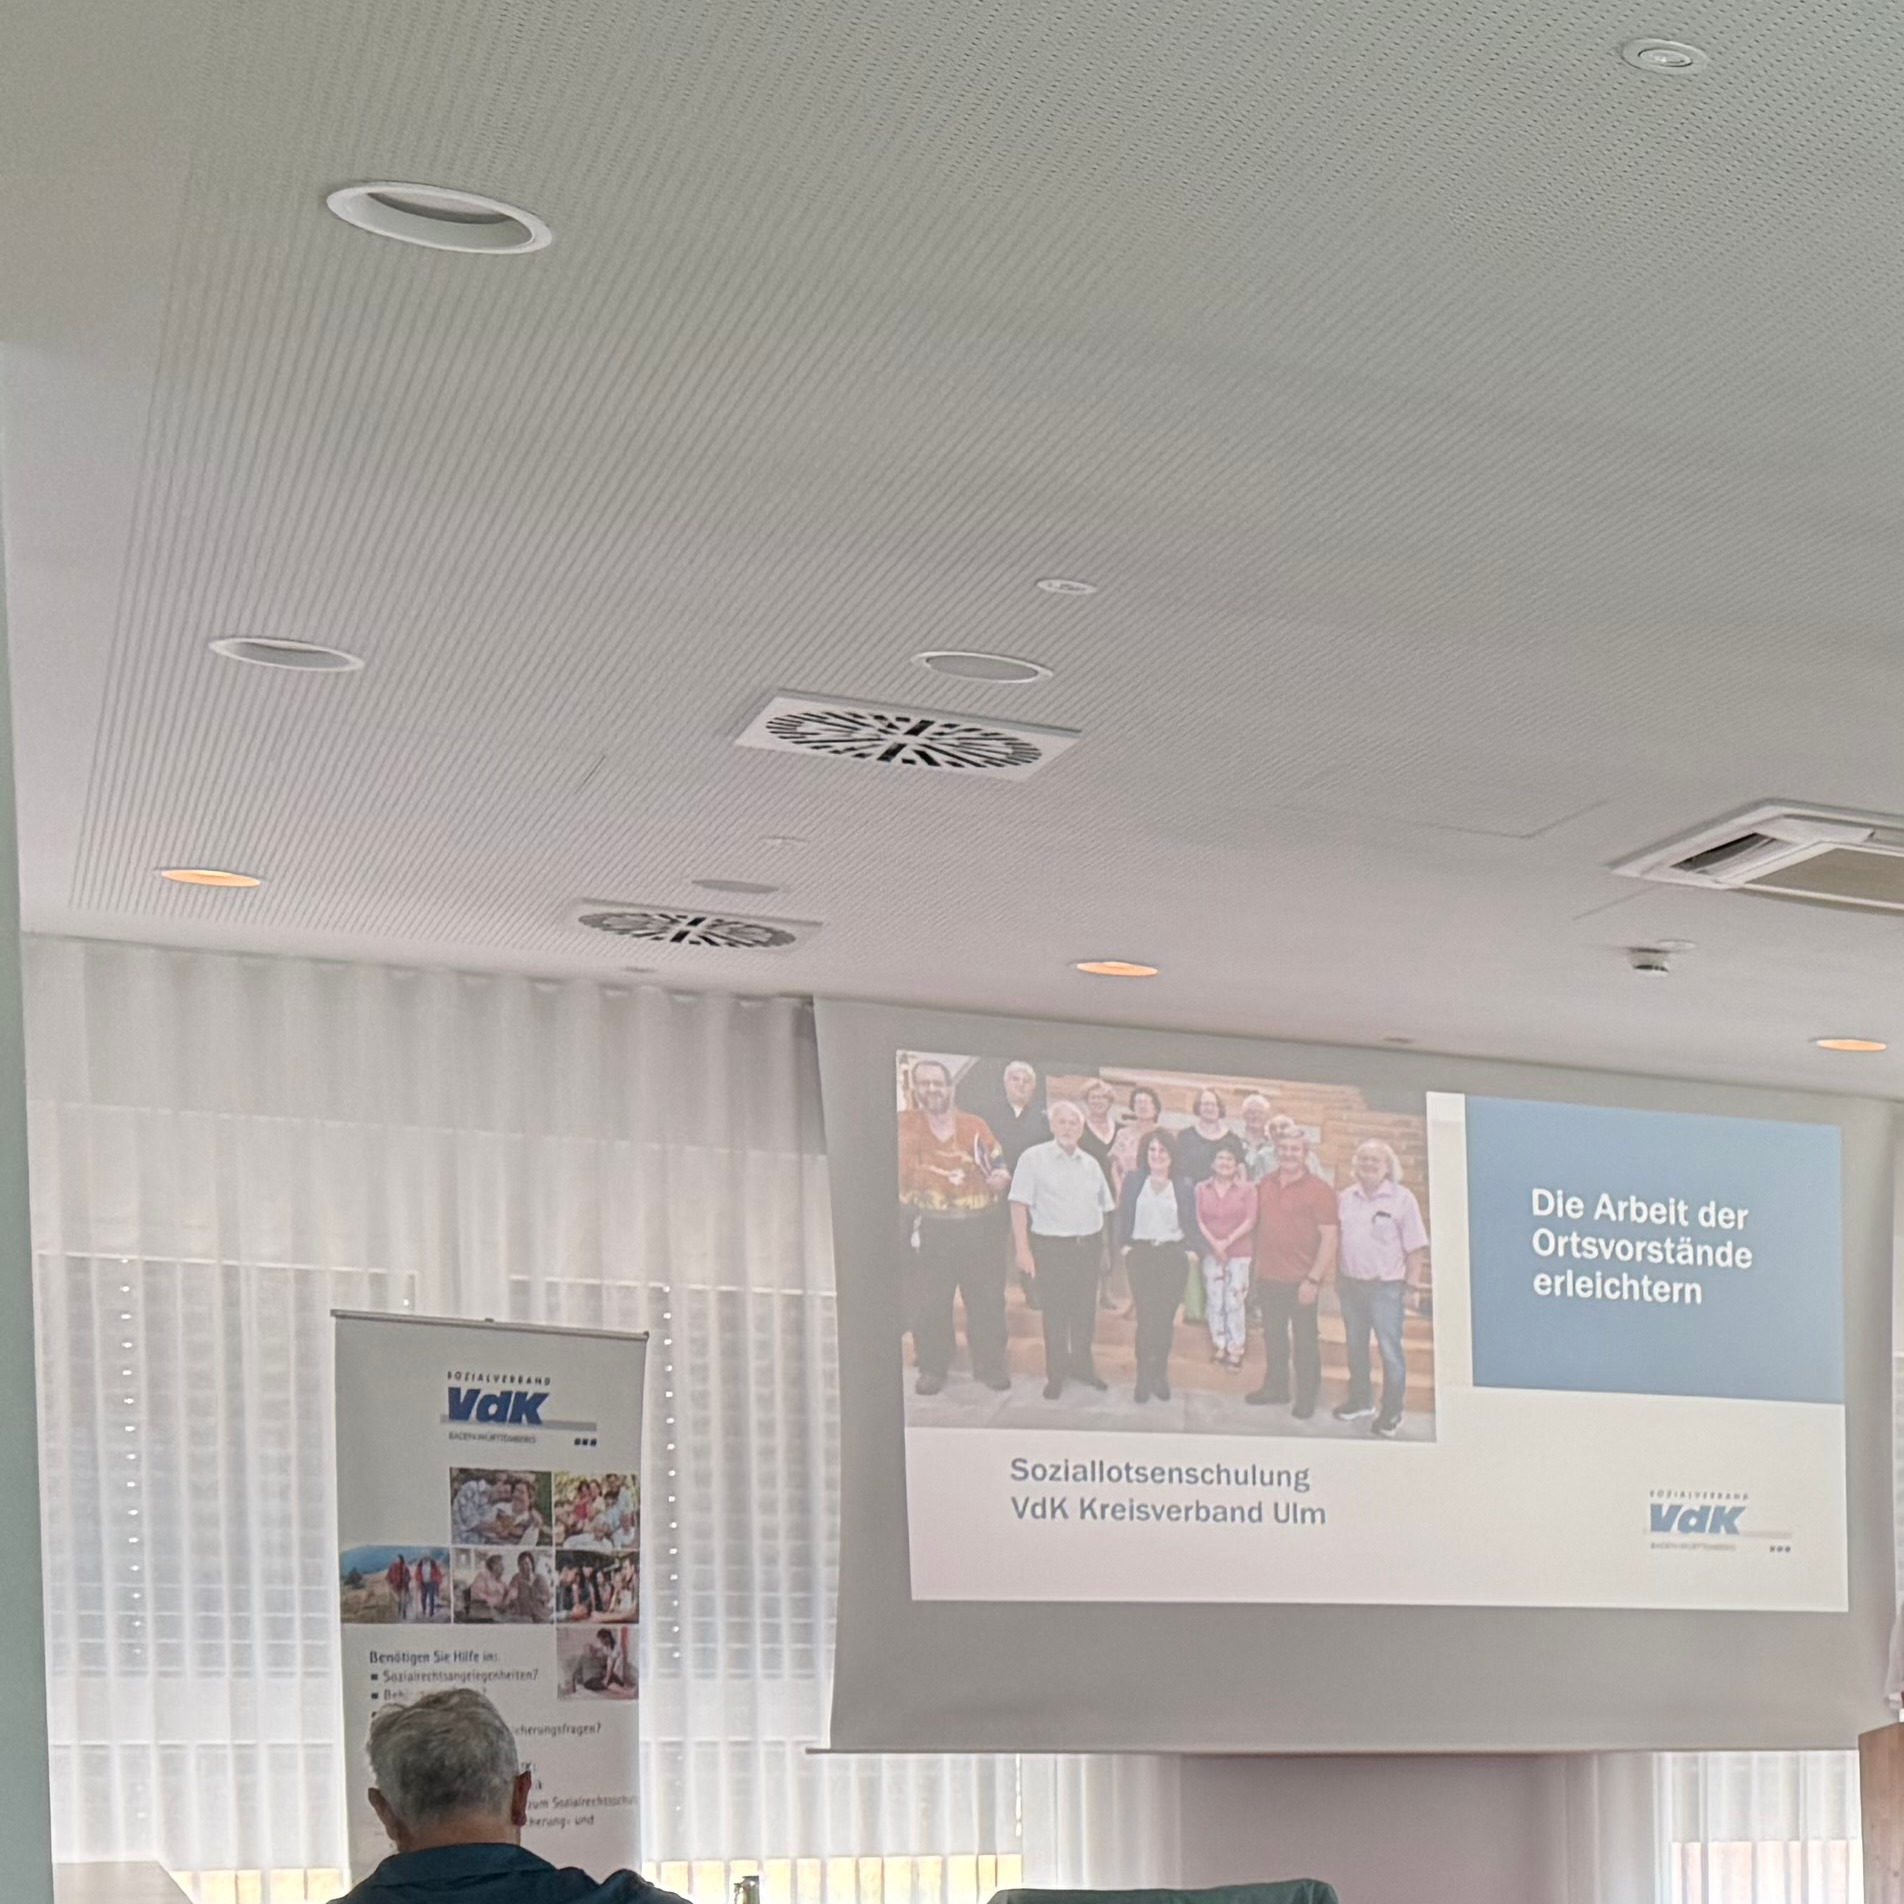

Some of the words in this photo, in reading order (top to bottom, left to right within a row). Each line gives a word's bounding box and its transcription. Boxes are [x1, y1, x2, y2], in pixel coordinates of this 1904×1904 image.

[1531, 1187, 1585, 1219] Die
[1593, 1192, 1690, 1228] Arbeit
[1697, 1200, 1749, 1231] der
[1531, 1227, 1753, 1270] Ortsvorstände
[1533, 1269, 1703, 1305] erleichtern
[447, 1371, 551, 1386] SOZIALVERBAND
[447, 1386, 550, 1425] VdK
[1010, 1457, 1311, 1493] Soziallotsenschulung
[1011, 1496, 1070, 1521] VdK
[1079, 1497, 1263, 1524] Kreisverband
[1273, 1501, 1327, 1525] Ulm
[1649, 1503, 1747, 1535] VdK
[369, 1650, 430, 1666] Benötigen
[433, 1651, 451, 1664] Sie
[453, 1650, 480, 1664] Hilfe
